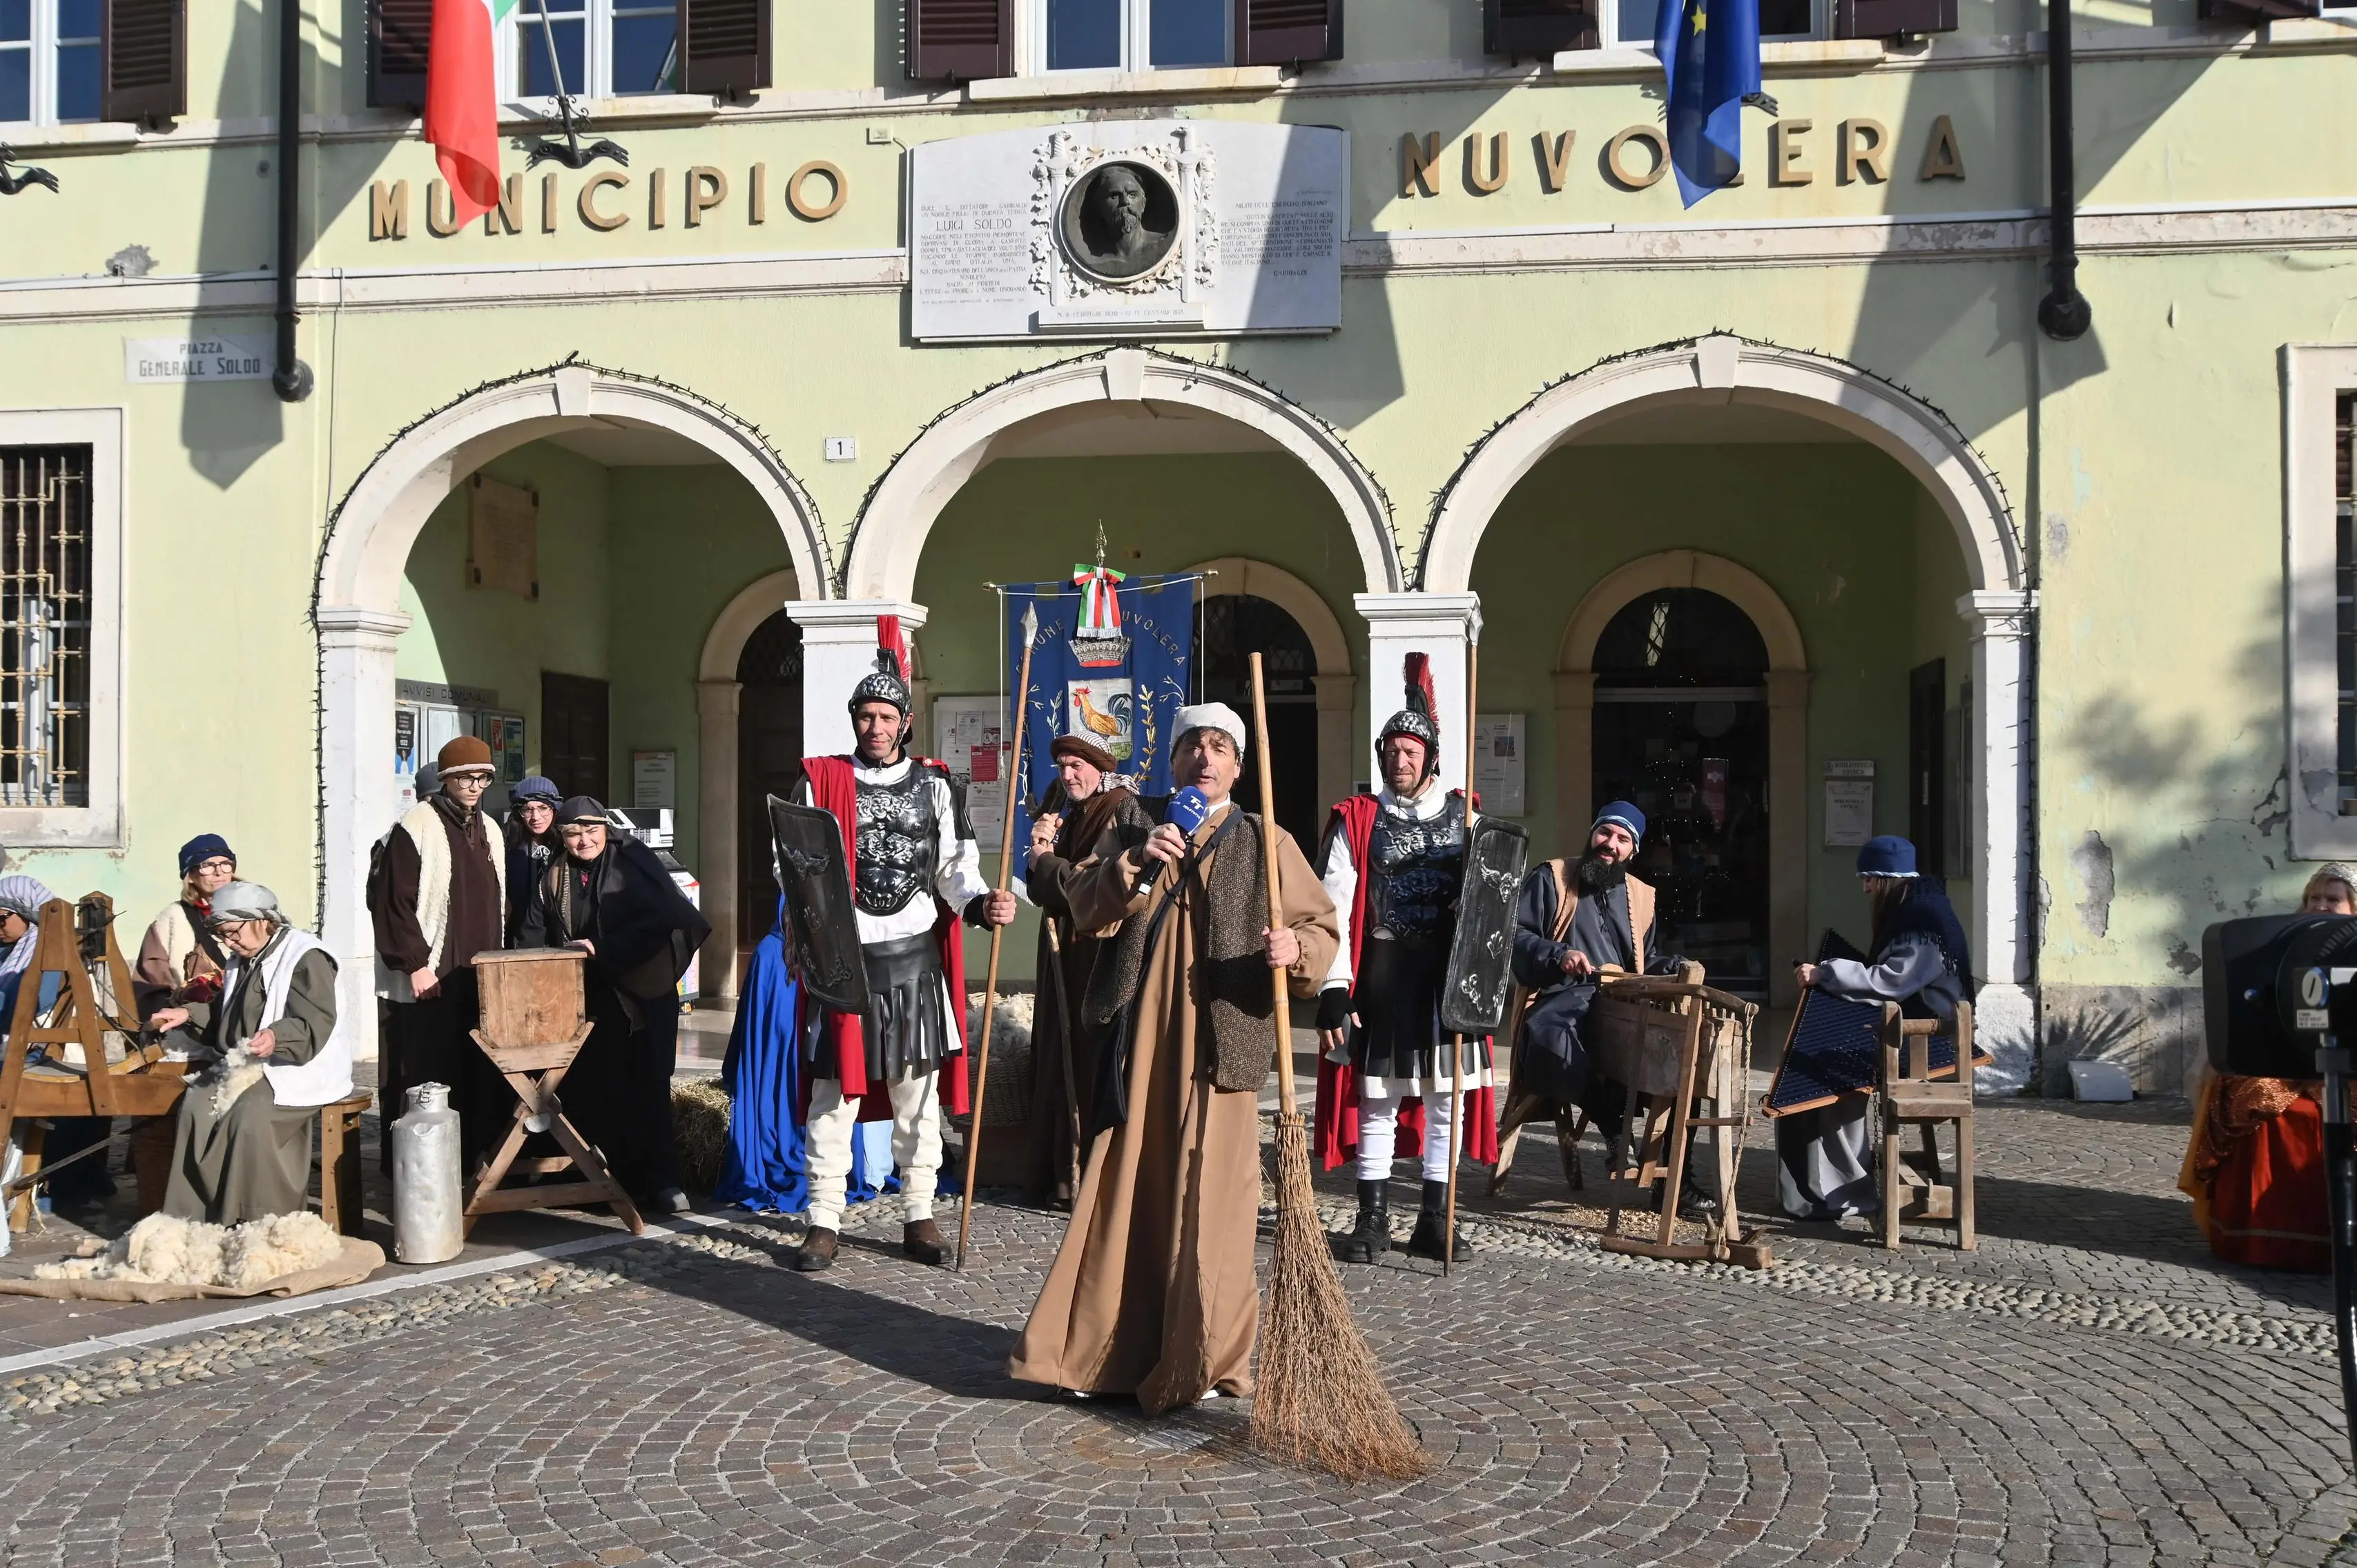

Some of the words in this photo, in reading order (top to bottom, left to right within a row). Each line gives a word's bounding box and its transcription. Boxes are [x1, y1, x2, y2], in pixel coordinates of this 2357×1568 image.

[1401, 114, 1967, 198] NUVOERA
[370, 159, 848, 240] MUNICIPIO
[936, 220, 963, 231] LUIGI
[973, 218, 1012, 230] SOLDO
[180, 342, 224, 355] PIAZZA
[139, 359, 206, 377] GENERALE
[216, 357, 261, 376] SOLDO
[837, 441, 842, 456] 1
[1120, 610, 1185, 666] UVOLERA
[402, 684, 435, 697] AVVISI
[440, 688, 489, 704] COMUNALI
